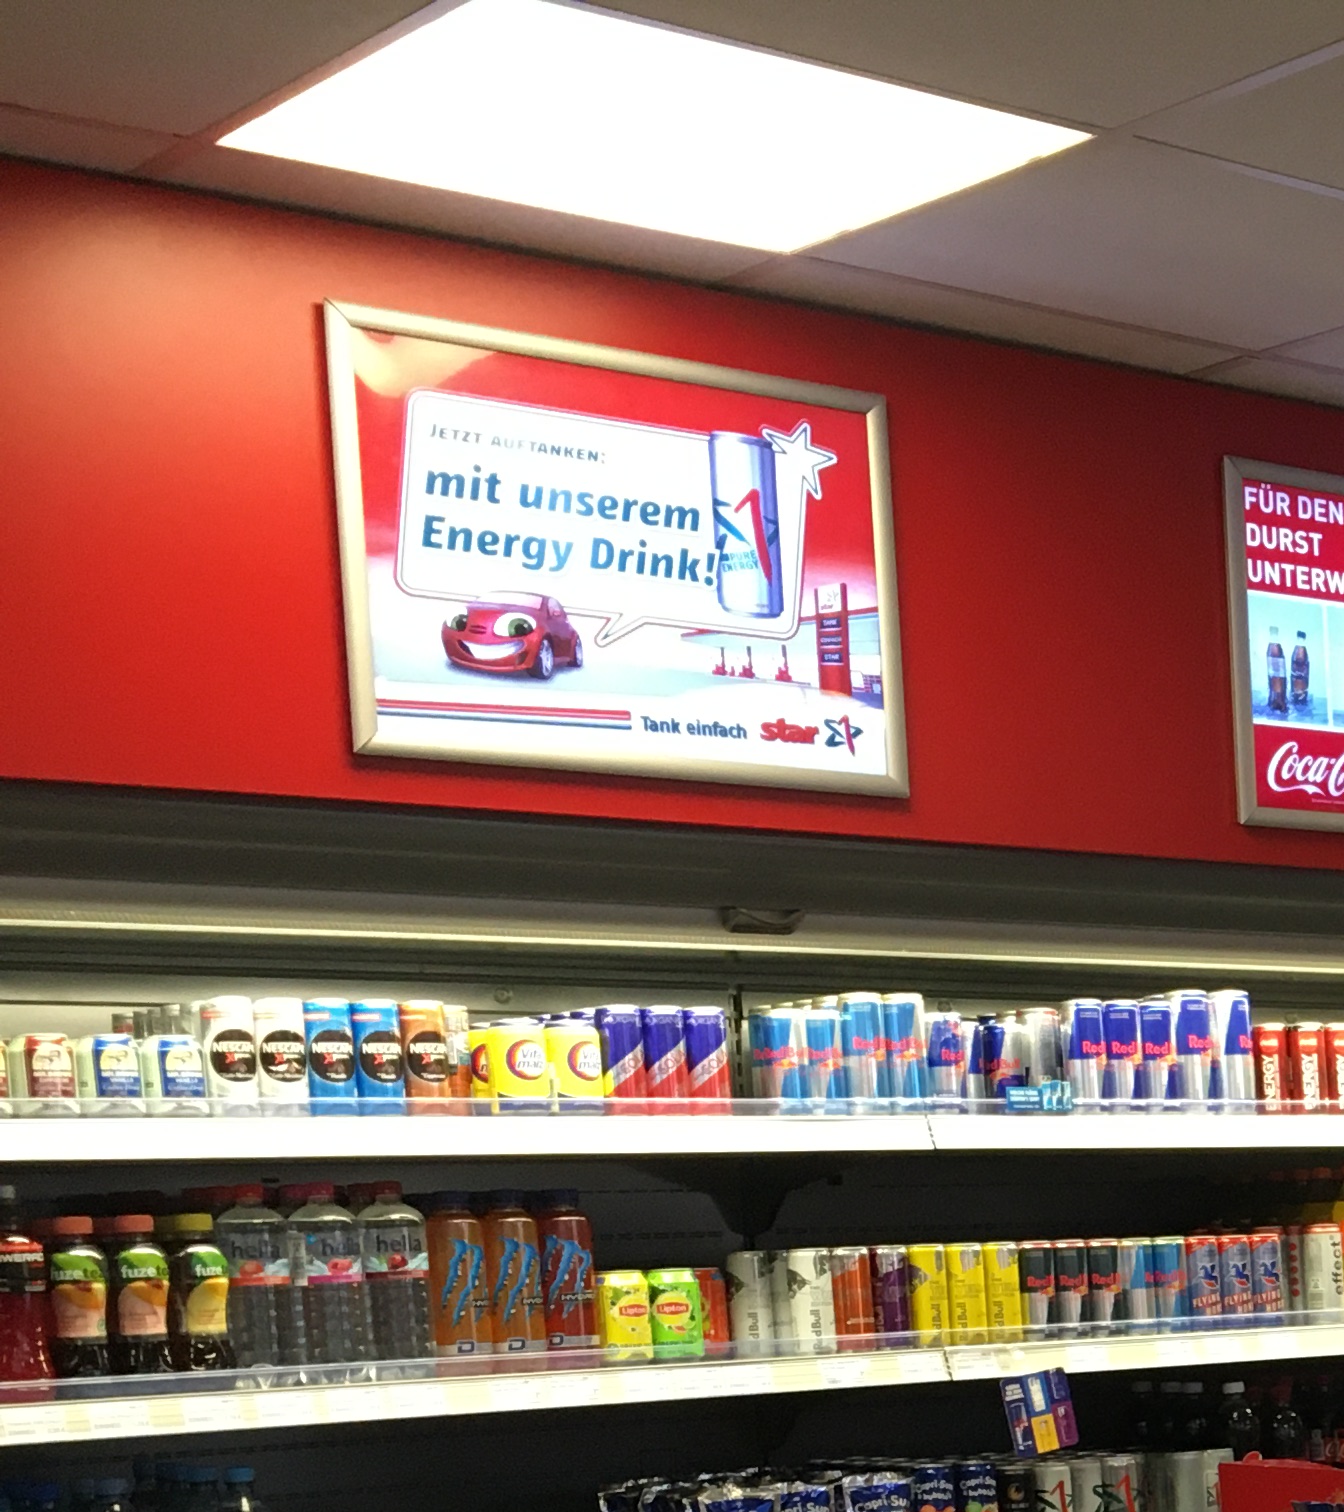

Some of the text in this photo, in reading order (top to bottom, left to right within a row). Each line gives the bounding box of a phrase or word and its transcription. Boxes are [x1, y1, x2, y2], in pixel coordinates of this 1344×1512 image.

[429, 423, 482, 445] JETZT
[424, 465, 702, 533] mit unserem
[1244, 483, 1344, 526] FÜR DEN
[421, 514, 720, 587] Energy Drink!
[1246, 523, 1322, 557] DURST
[640, 715, 819, 746] Tank einfach star
[231, 1240, 281, 1261] hella
[375, 1233, 423, 1255] hella
[1331, 1241, 1343, 1296] effect
[620, 1303, 647, 1317] Lipton
[657, 1302, 690, 1315] Lipton
